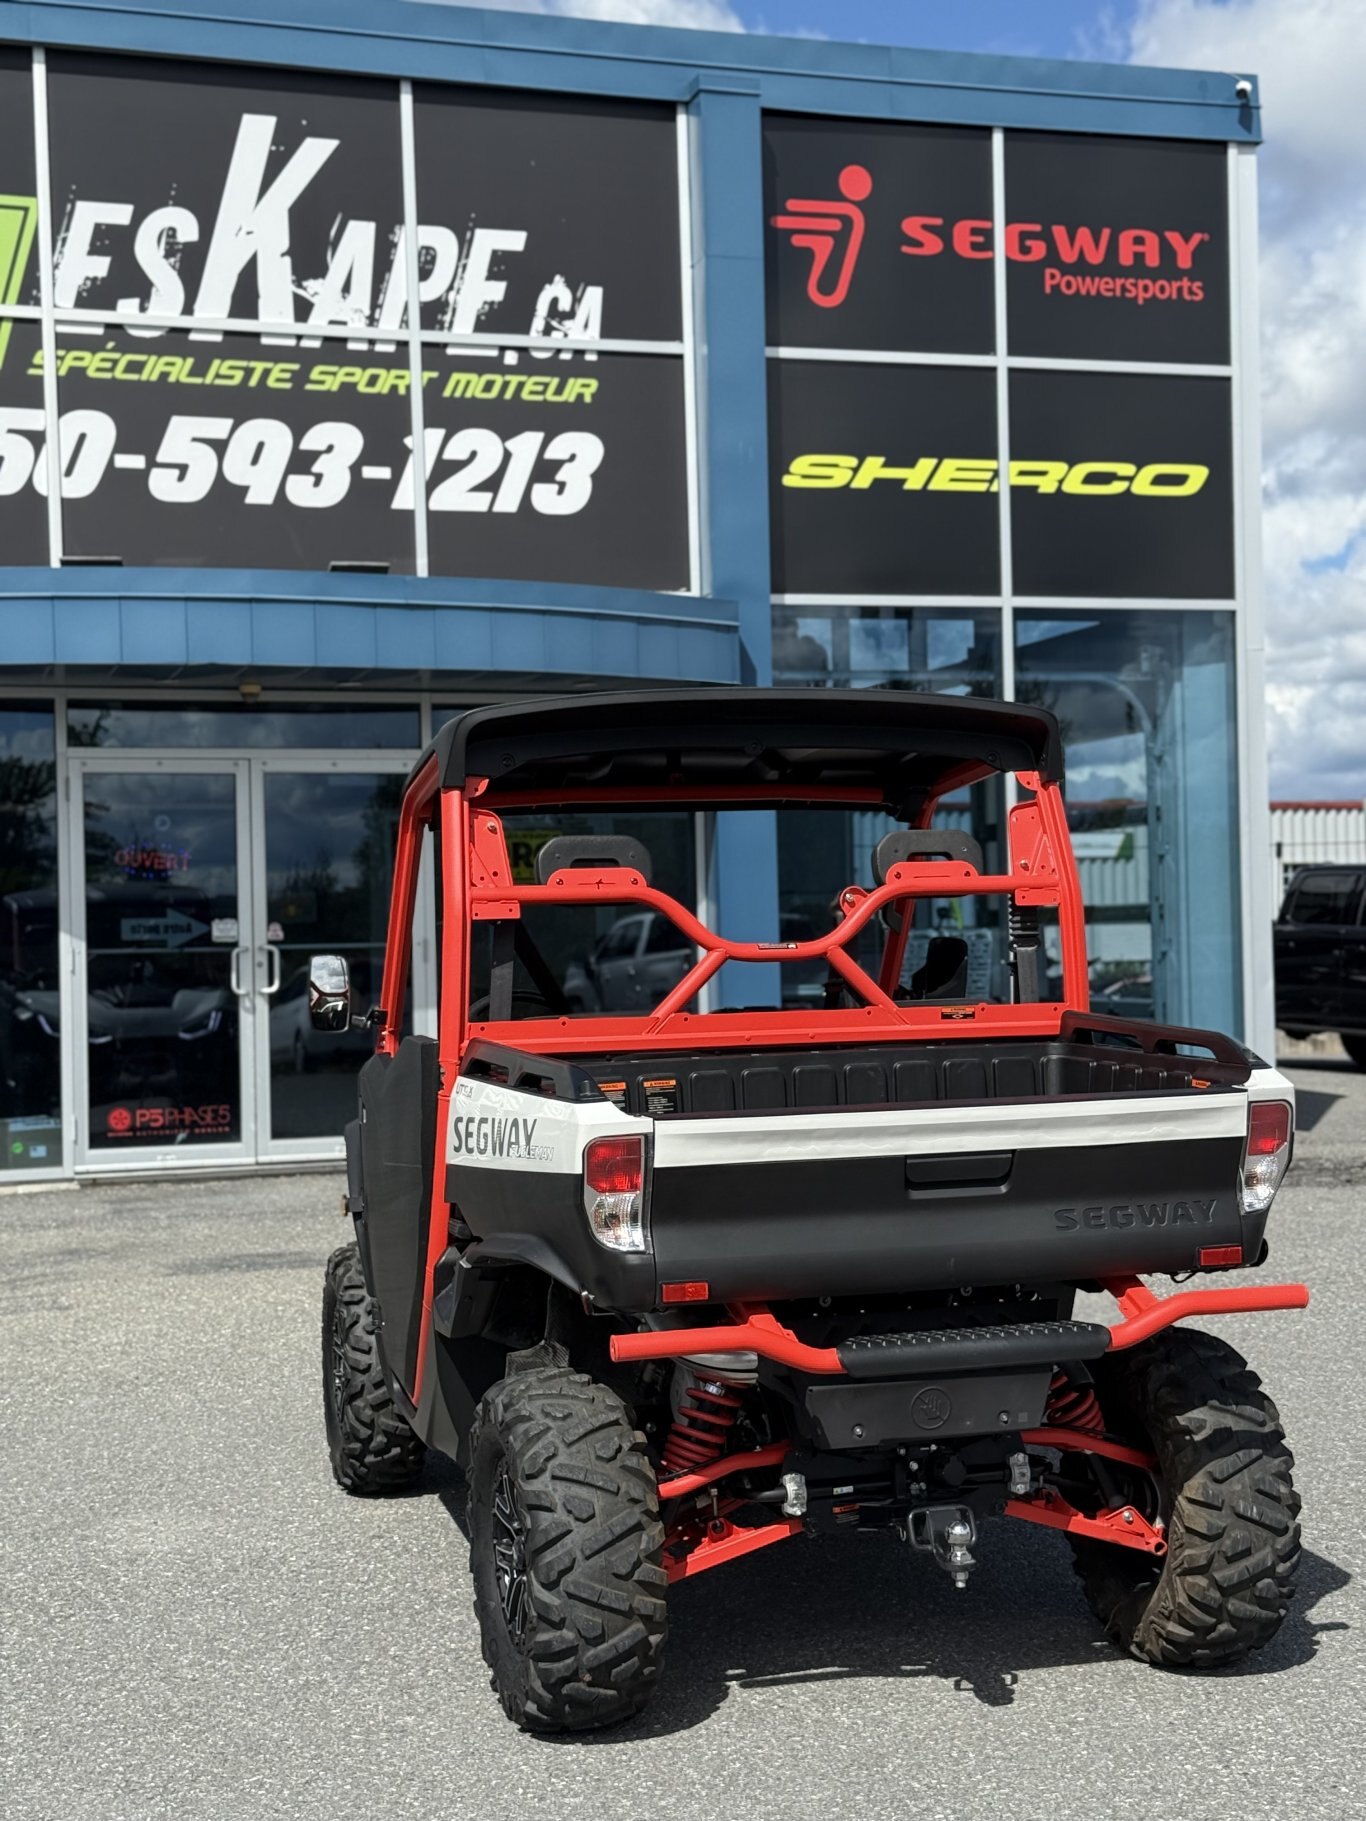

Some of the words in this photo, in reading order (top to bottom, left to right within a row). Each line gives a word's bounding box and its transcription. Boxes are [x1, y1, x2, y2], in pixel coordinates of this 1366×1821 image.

[900, 216, 1204, 269] SEGWAY
[1044, 268, 1204, 304] Powersports
[27, 341, 299, 389] SPÉCIALISTE
[305, 364, 439, 396] SPORT
[442, 372, 599, 403] MOTEUR
[782, 454, 1209, 496] SHERCO
[115, 851, 191, 872] OUVERT
[453, 1116, 538, 1157] SEGWAY
[1054, 1199, 1217, 1232] SEGWAY
